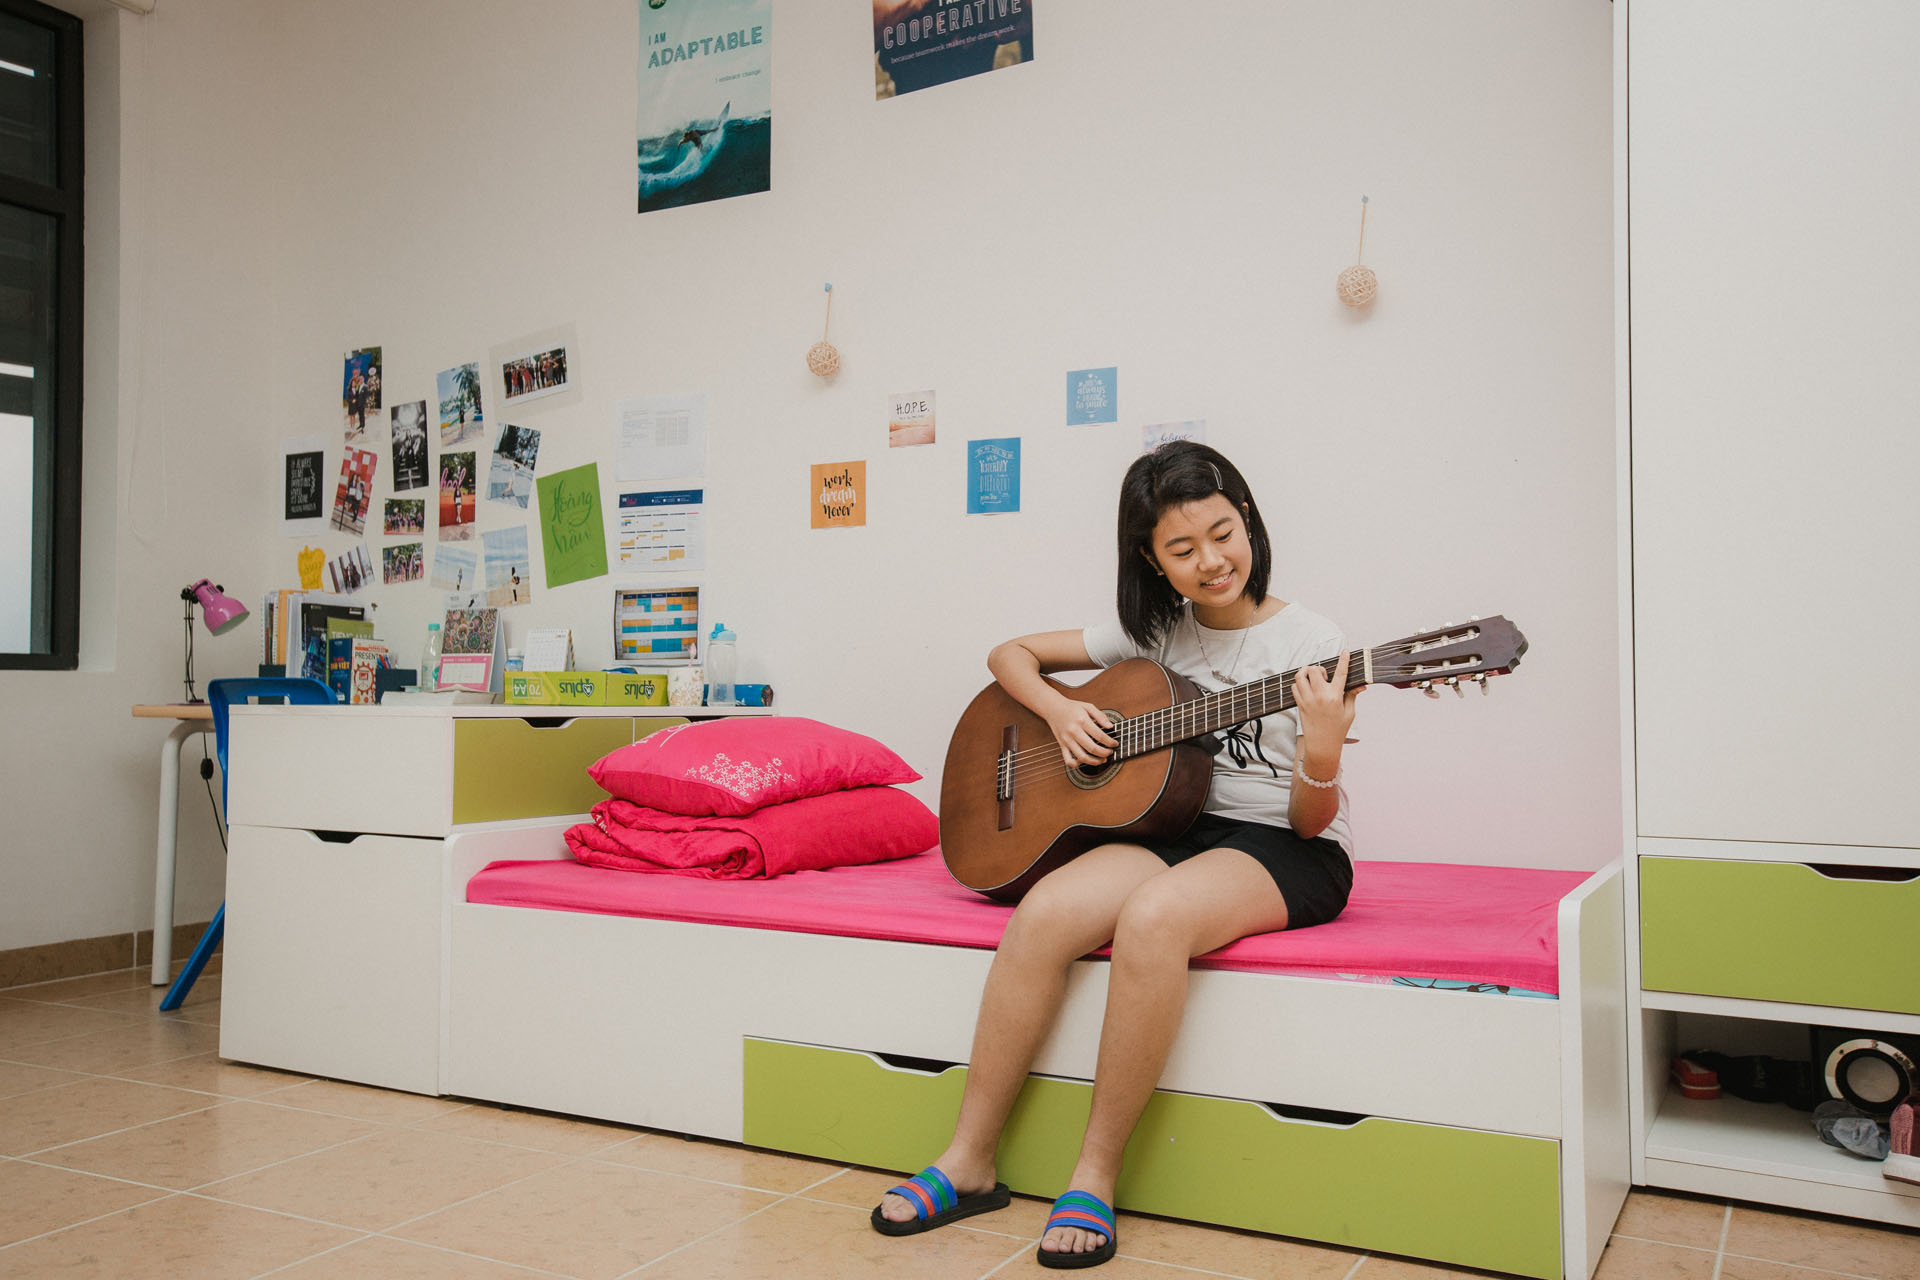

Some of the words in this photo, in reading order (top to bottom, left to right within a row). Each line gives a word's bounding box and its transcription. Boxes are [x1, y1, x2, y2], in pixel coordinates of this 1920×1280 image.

[883, 0, 1022, 49] COOPERATIVE
[654, 31, 667, 44] AM
[945, 38, 965, 49] makes
[966, 35, 977, 44] the
[647, 26, 763, 69] ADAPTABLE
[823, 468, 853, 489] work
[819, 487, 857, 505] dream
[823, 502, 855, 520] never
[513, 684, 527, 696] A4
[529, 684, 542, 696] 70
